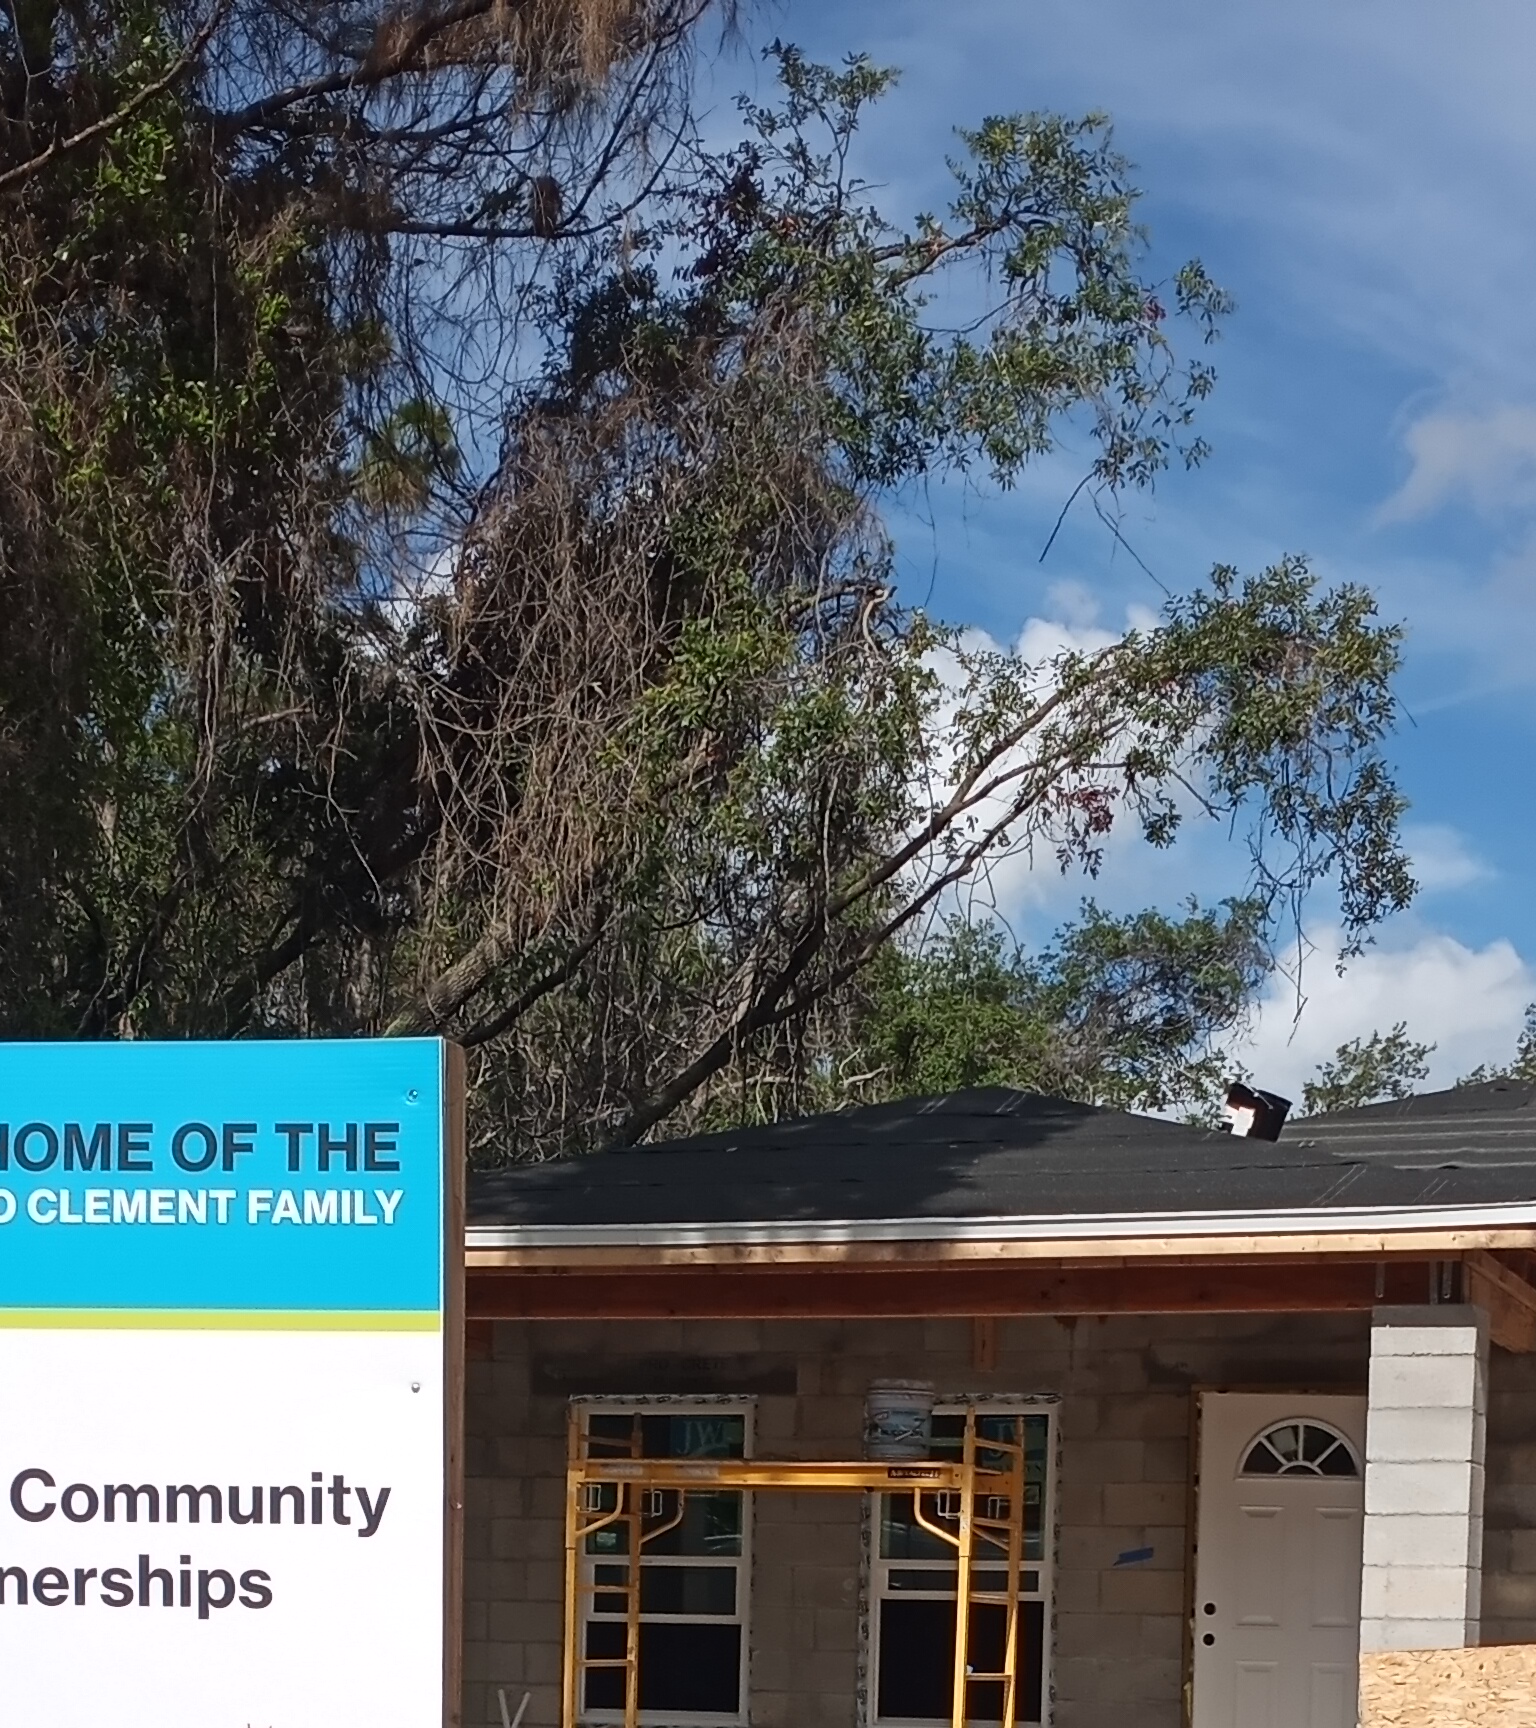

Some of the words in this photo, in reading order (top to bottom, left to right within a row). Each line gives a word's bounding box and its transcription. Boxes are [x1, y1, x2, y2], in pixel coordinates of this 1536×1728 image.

[172, 1123, 257, 1172] OF
[275, 1123, 400, 1171] THE
[28, 1189, 238, 1225] CLEMENT
[249, 1190, 404, 1226] FAMILY
[10, 1468, 391, 1537] Community
